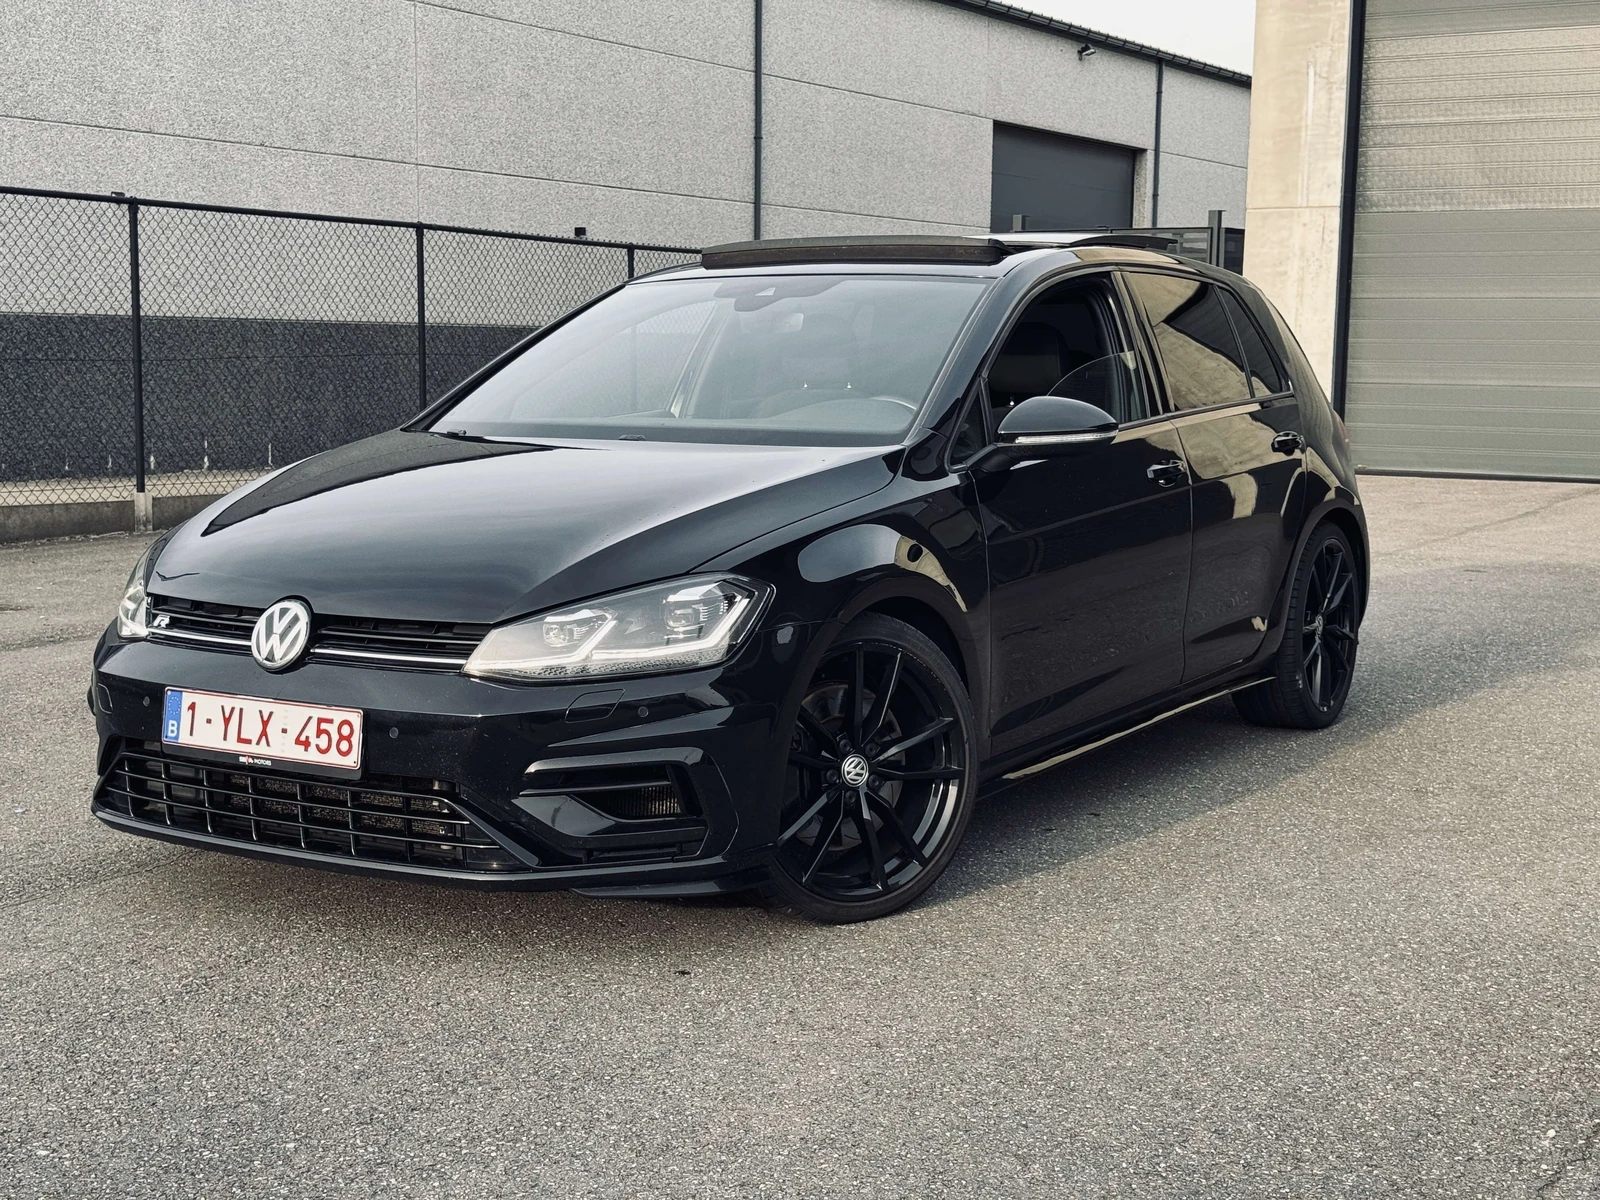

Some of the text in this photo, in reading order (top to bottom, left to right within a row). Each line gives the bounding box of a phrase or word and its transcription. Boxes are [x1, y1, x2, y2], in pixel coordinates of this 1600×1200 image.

[153, 614, 170, 628] R
[168, 720, 178, 737] B
[187, 702, 354, 757] 1-YLX-458
